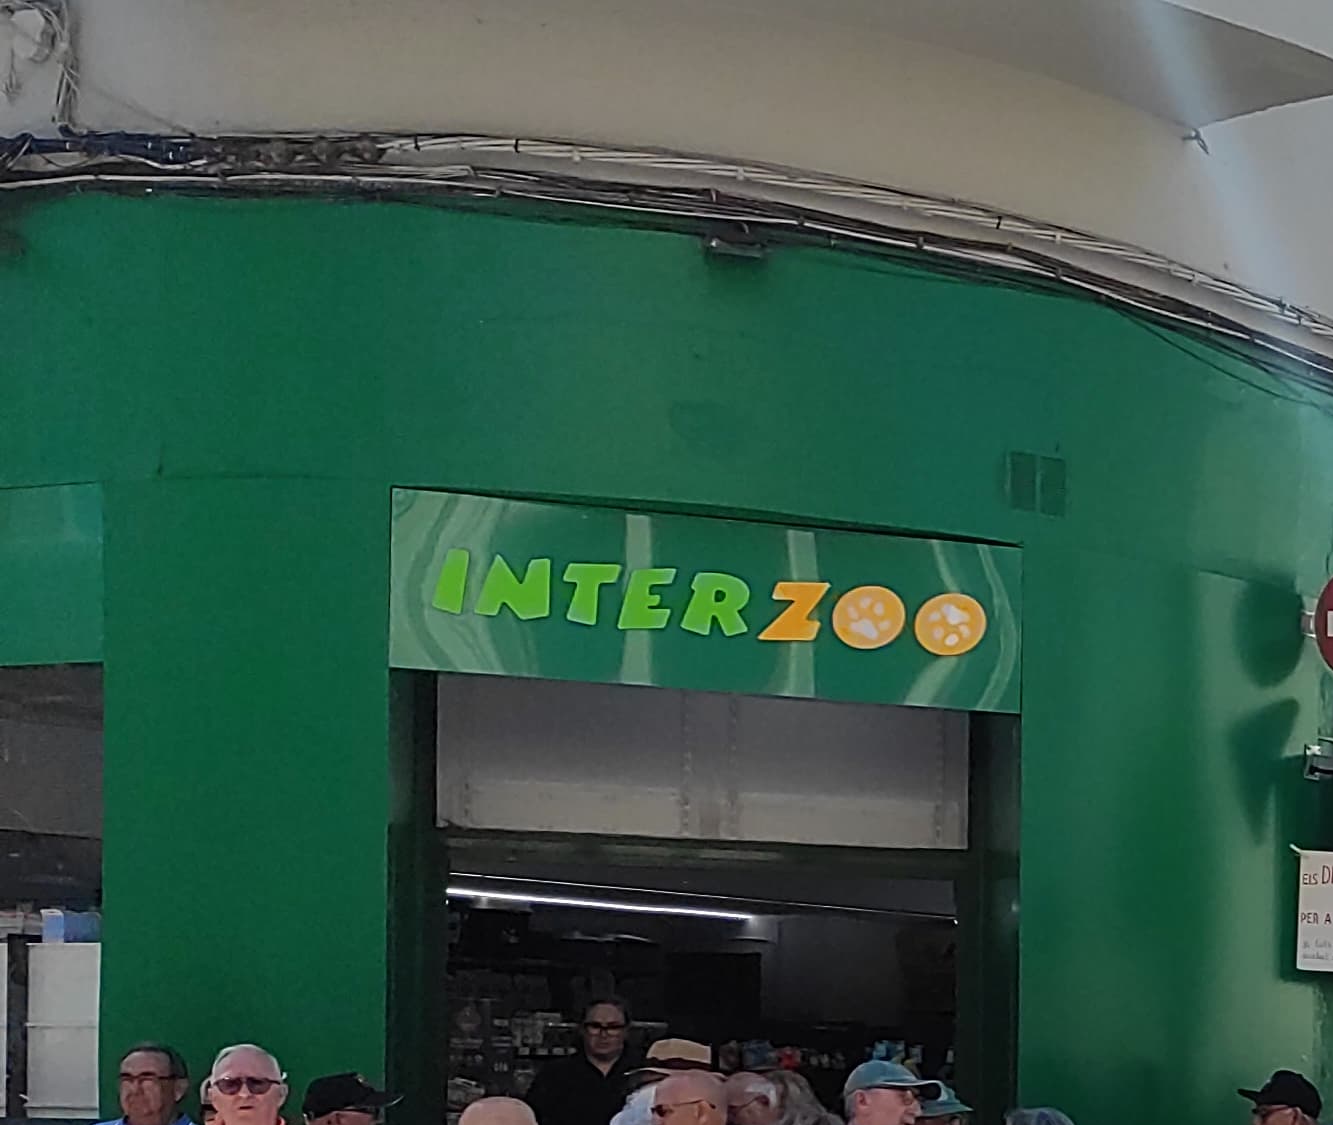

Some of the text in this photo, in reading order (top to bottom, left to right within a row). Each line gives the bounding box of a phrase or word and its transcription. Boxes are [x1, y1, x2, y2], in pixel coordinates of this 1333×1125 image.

[431, 547, 986, 656] INTERZOO
[1300, 912, 1319, 925] PER
[1324, 914, 1332, 924] A
